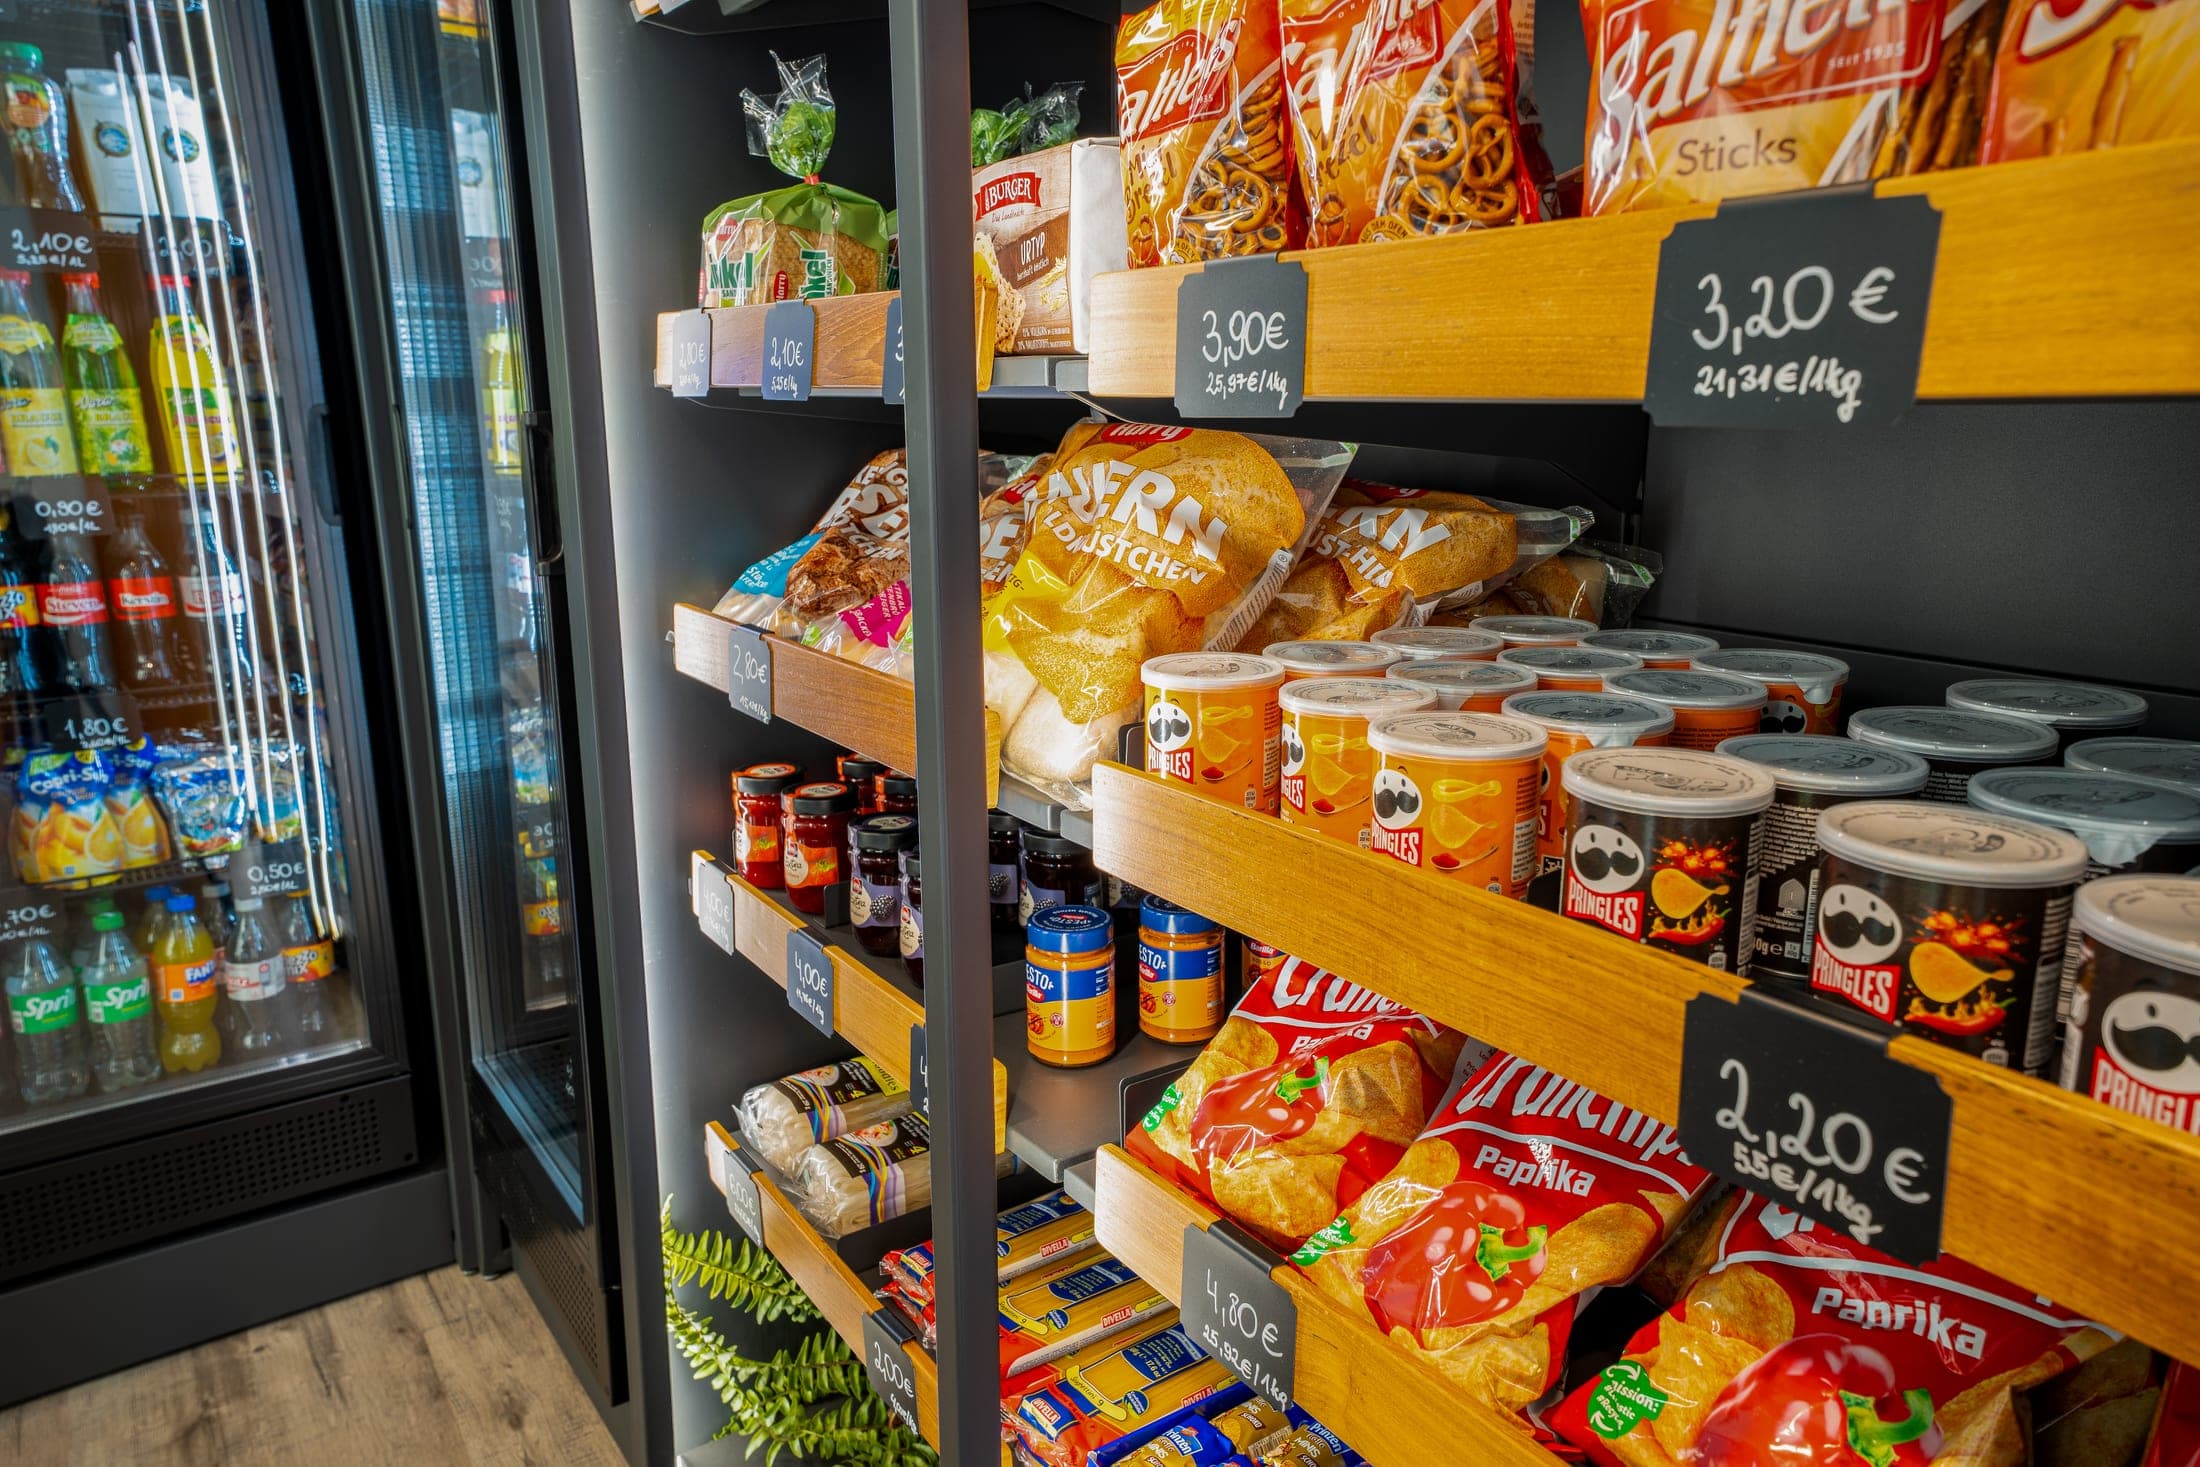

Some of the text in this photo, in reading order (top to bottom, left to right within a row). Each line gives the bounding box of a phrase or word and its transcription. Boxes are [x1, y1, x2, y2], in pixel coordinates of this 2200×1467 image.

[1676, 127, 1797, 177] Sticks
[770, 336, 804, 370] 2,10€
[1202, 310, 1289, 368] 3,90€
[64, 717, 129, 740] 1,80€
[247, 862, 305, 884] 0,50€
[1568, 884, 1640, 935] PRINGLES
[794, 950, 828, 998] 4,00€
[1812, 950, 1894, 1016] PRINGLES
[1102, 1306, 1131, 1328] DIVELLA
[1812, 1287, 1987, 1360] Paprika
[874, 1341, 915, 1399] 2,00€
[1309, 1422, 1343, 1453] Prinzen
